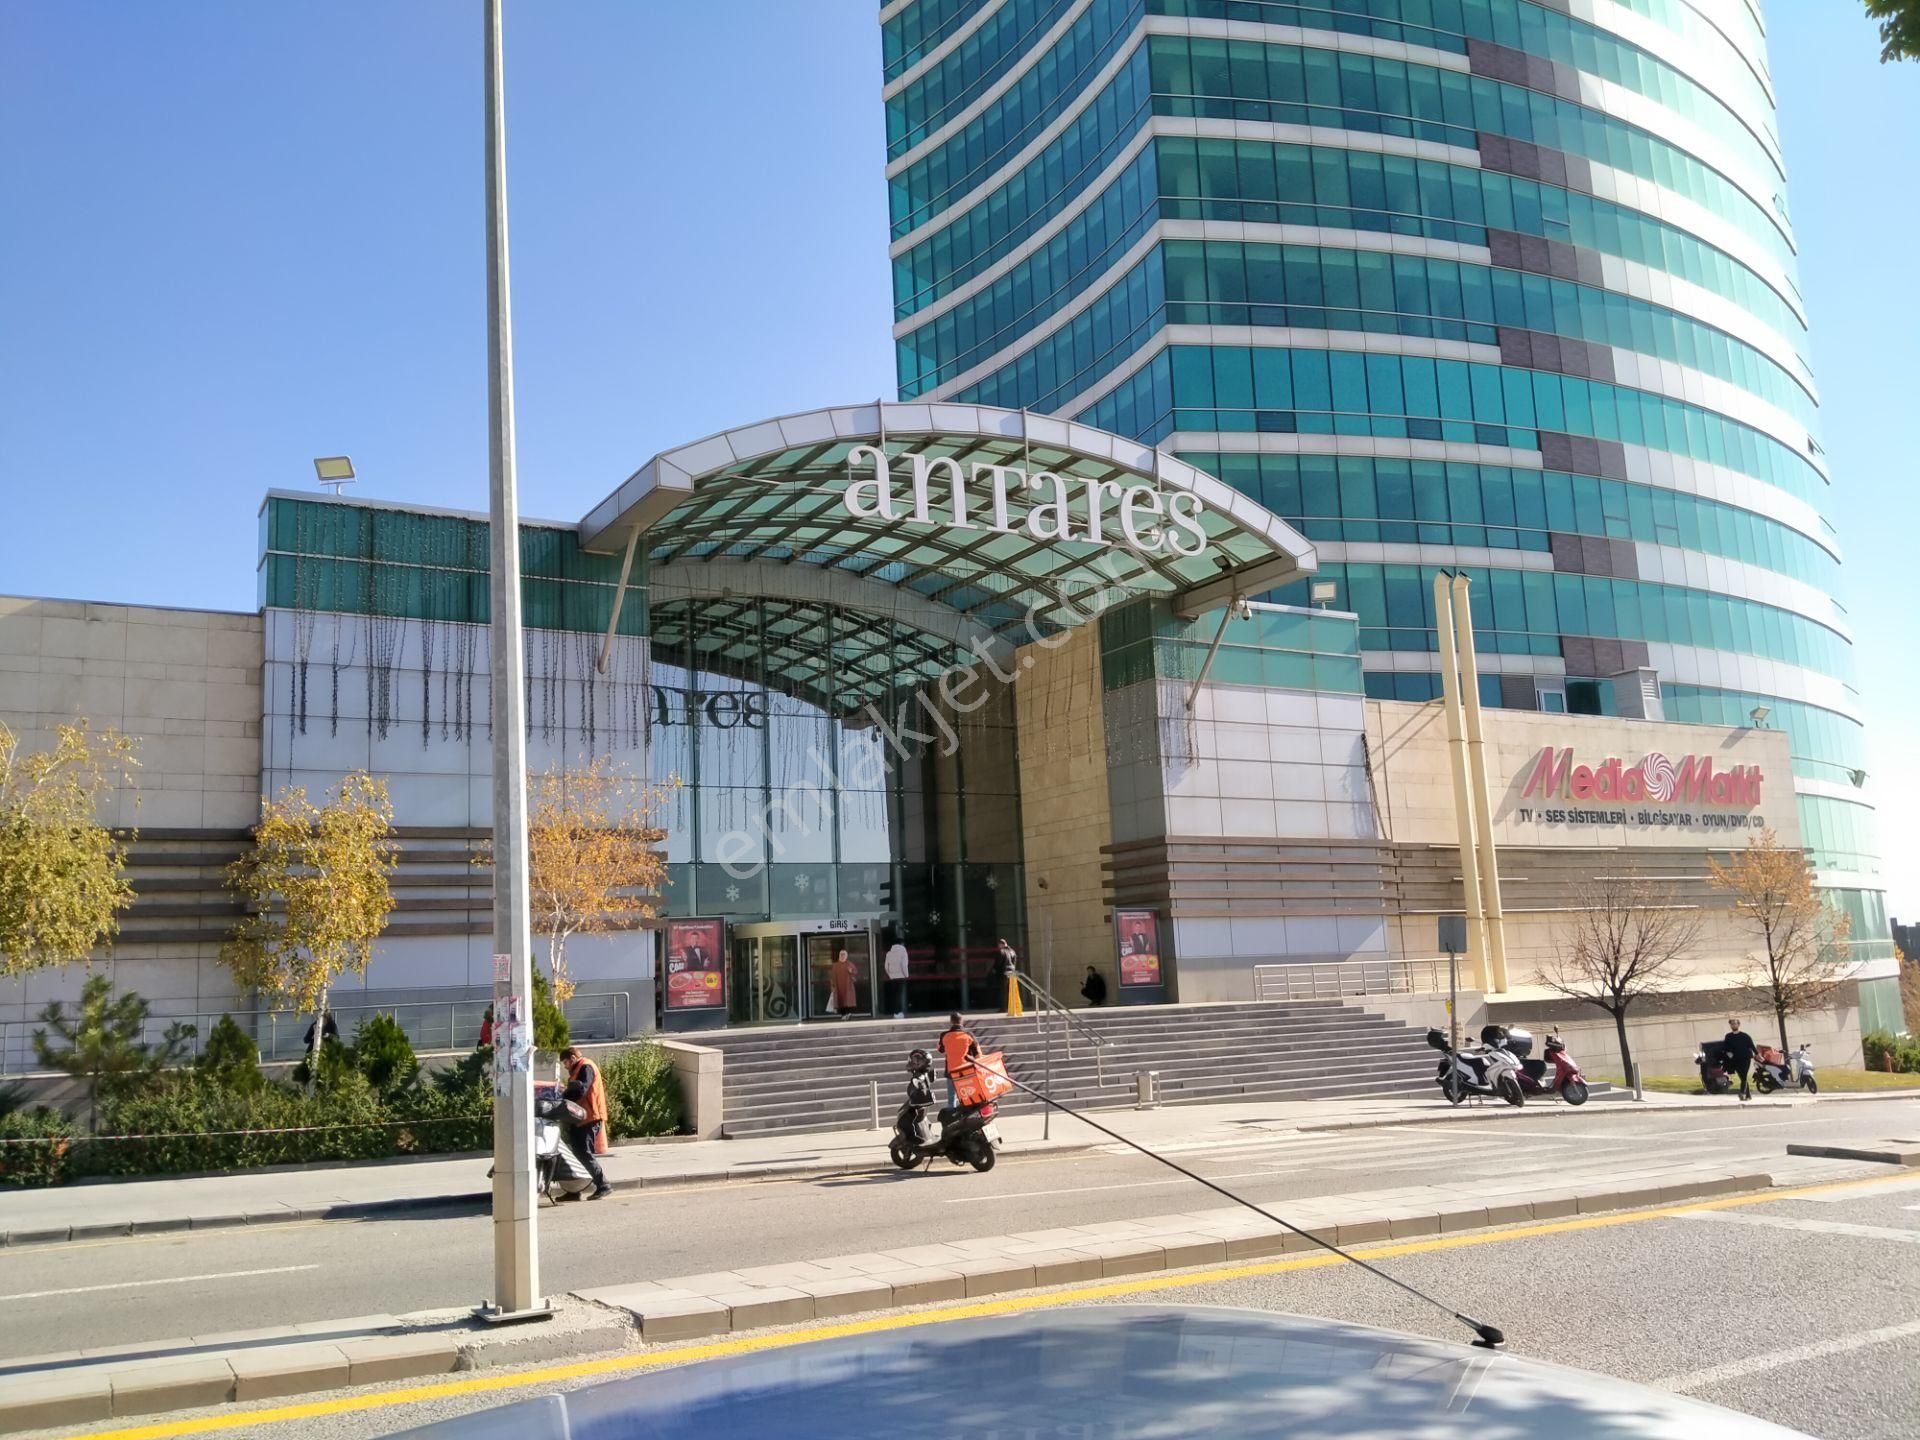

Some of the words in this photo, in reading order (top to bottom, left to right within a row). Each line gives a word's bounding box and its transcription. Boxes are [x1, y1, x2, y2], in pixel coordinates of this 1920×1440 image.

[1520, 808, 1533, 822] TV
[1546, 809, 1566, 823] SES
[1568, 807, 1627, 825] SİSTEMLERİ
